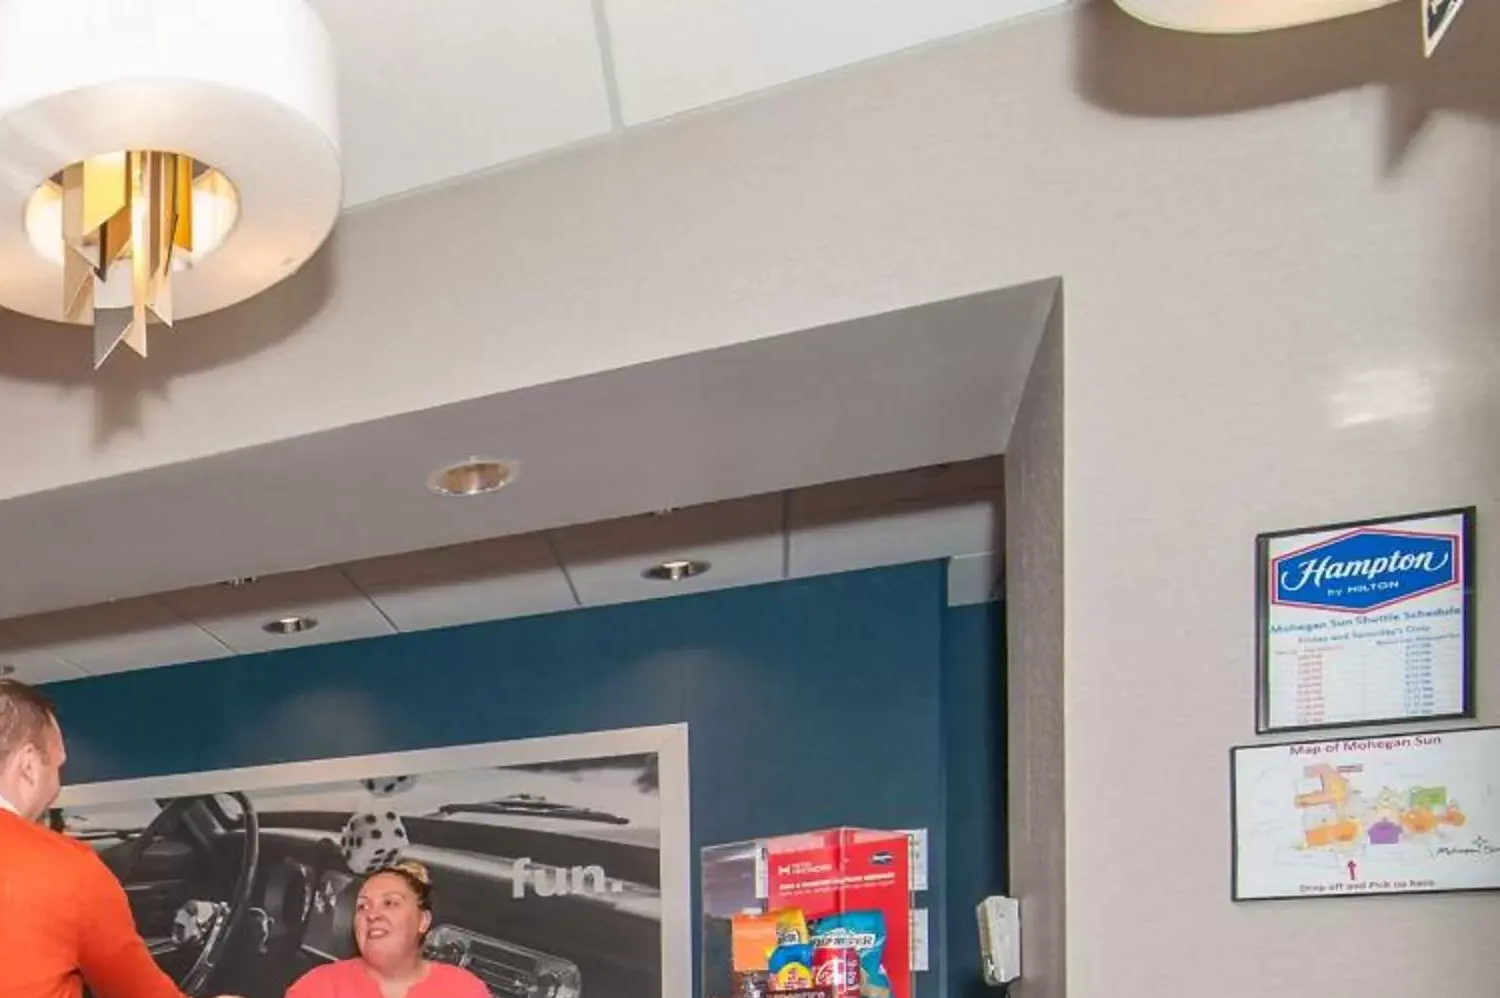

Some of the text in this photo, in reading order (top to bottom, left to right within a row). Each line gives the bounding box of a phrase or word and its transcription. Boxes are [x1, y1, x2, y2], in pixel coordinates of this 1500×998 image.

[1281, 550, 1449, 591] Hampton
[1347, 580, 1400, 594] HILTON
[1330, 617, 1353, 628] Sun
[1355, 613, 1399, 625] Shuttle
[1402, 605, 1461, 620] Schedule
[1289, 735, 1442, 755] Map of Mohegan Sun
[513, 857, 622, 898] fun.
